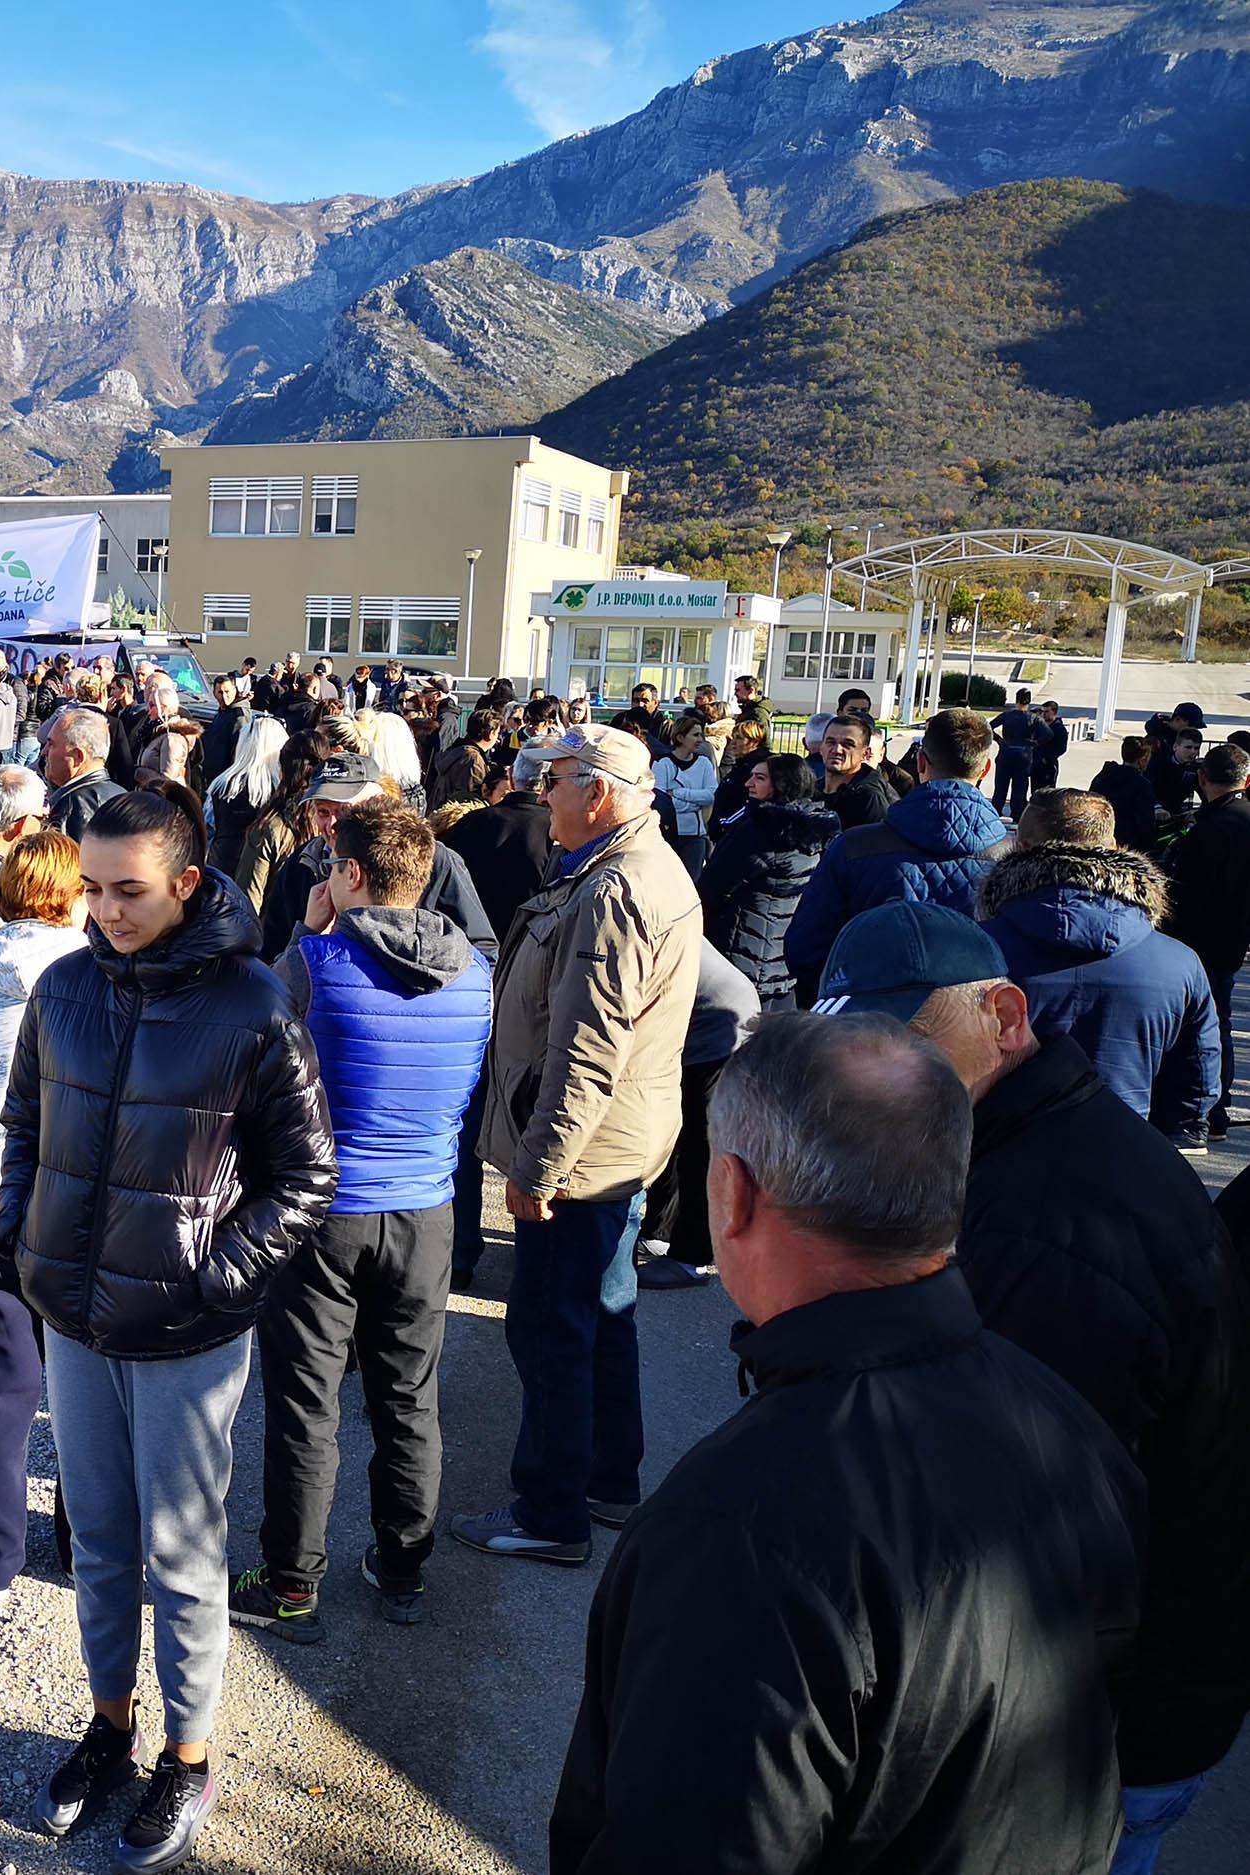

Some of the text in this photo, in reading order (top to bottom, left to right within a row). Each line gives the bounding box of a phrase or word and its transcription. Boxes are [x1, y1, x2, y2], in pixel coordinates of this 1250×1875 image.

[596, 592, 718, 607] J.P. DEPONIJA d.o.o. Mostar
